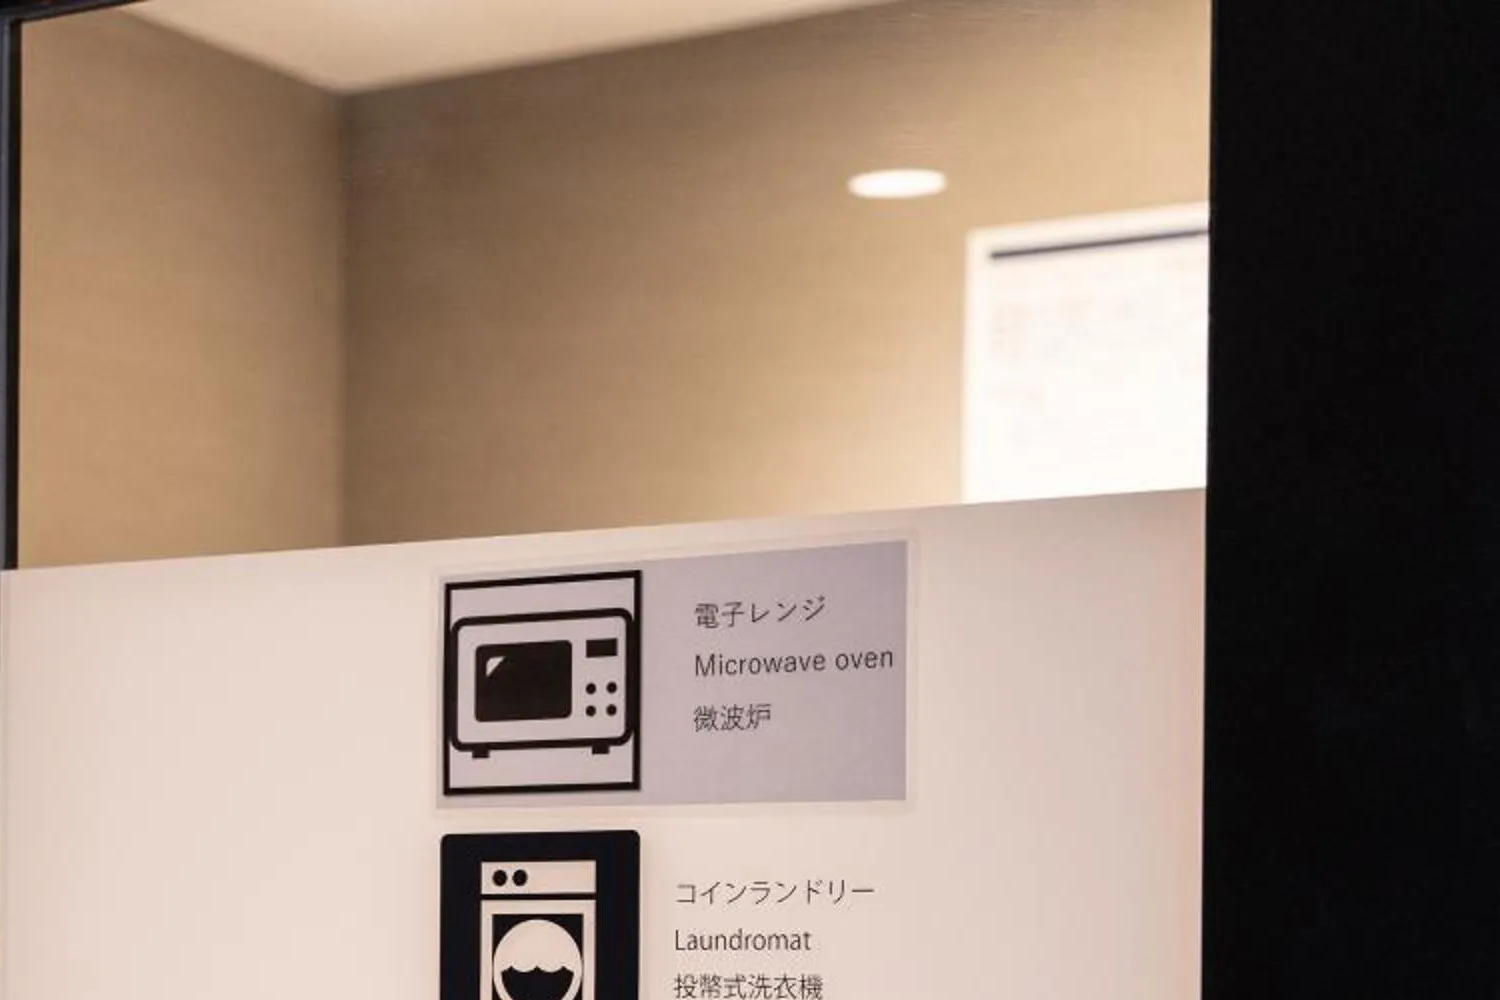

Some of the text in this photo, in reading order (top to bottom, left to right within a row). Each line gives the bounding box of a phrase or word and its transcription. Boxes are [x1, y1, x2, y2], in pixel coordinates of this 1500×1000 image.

[694, 595, 826, 629] 電子レンジ
[694, 650, 894, 677] Microwave oven
[693, 703, 772, 732] 微波炉
[675, 879, 876, 905] コインランドリー
[674, 928, 812, 951] Laundromat
[673, 973, 824, 1000] 投幣式洗衣機
